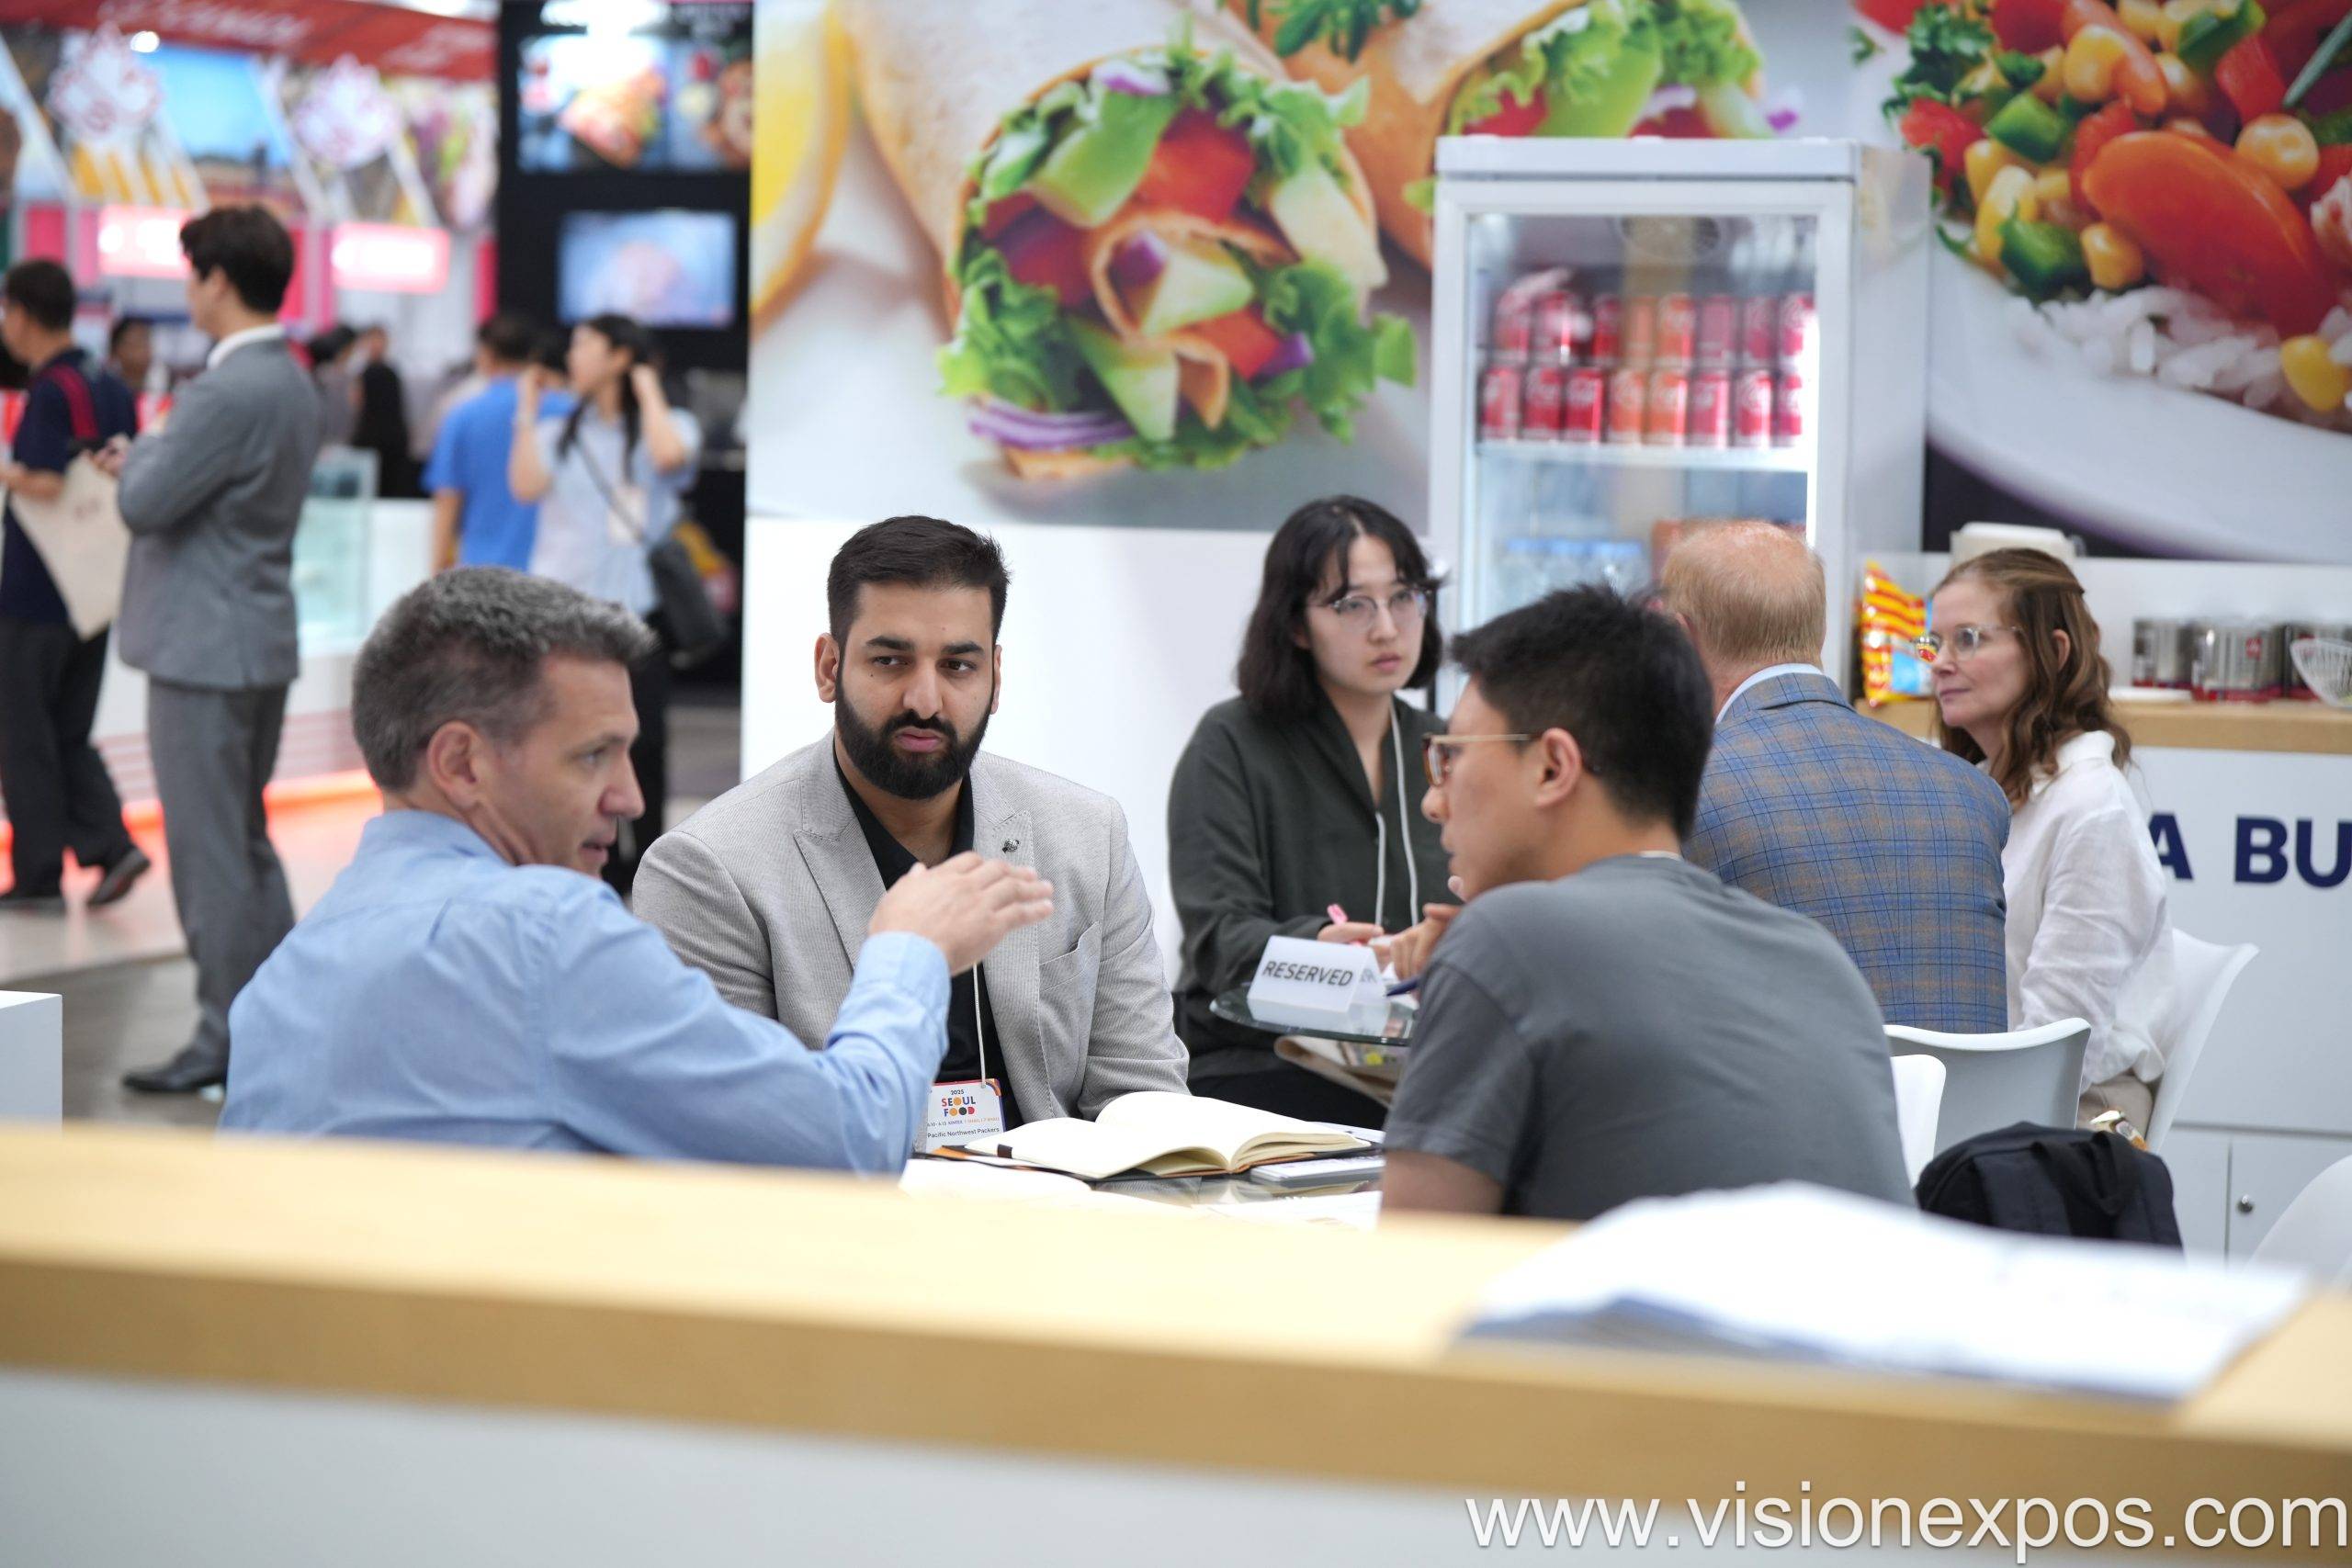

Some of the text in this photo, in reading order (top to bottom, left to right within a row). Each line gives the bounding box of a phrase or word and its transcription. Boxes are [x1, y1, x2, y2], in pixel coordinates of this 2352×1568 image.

[2234, 815, 2352, 888] BU
[1261, 961, 1353, 987] RESERVED
[941, 1096, 976, 1107] SEOUL
[944, 1107, 975, 1117] FOOD
